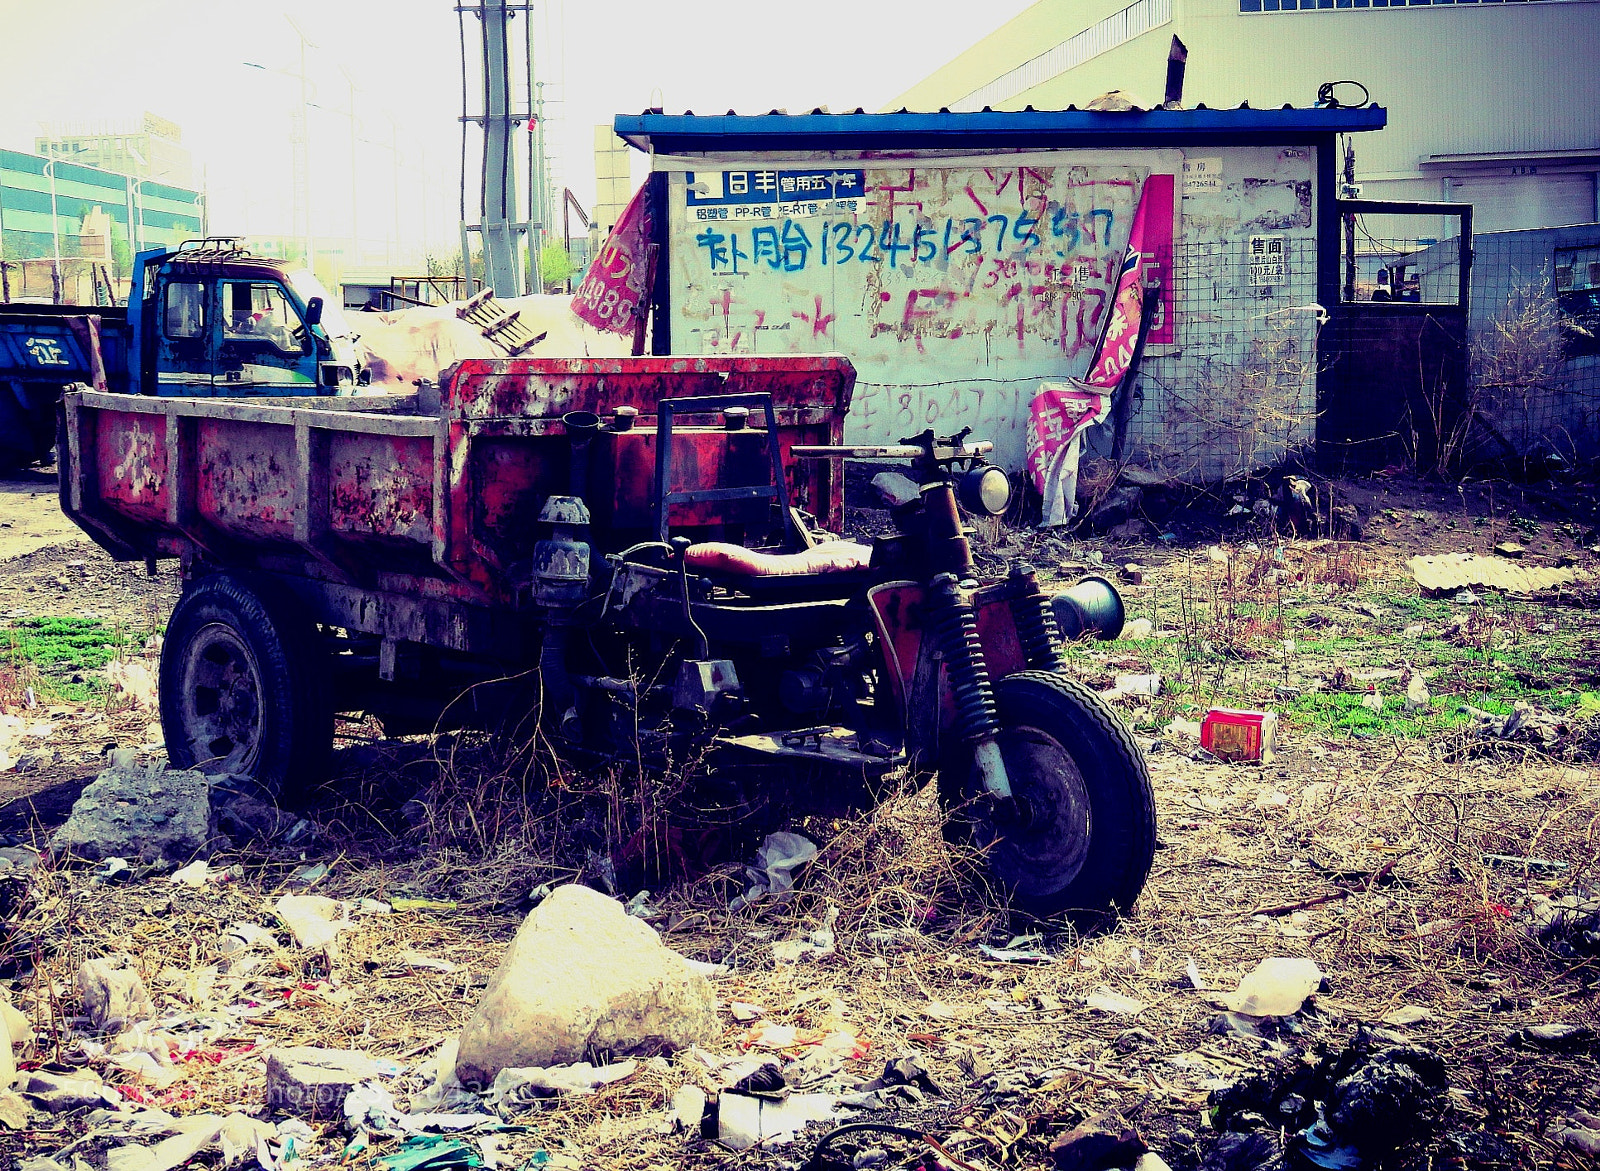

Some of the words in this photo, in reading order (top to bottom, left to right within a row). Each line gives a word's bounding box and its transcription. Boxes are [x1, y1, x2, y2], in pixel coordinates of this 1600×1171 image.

[729, 171, 776, 194] 日丰
[781, 173, 857, 192] 管用五年
[696, 207, 729, 220] 铝塑管
[735, 206, 772, 218] PP-R管
[821, 207, 1114, 268] 13245137557
